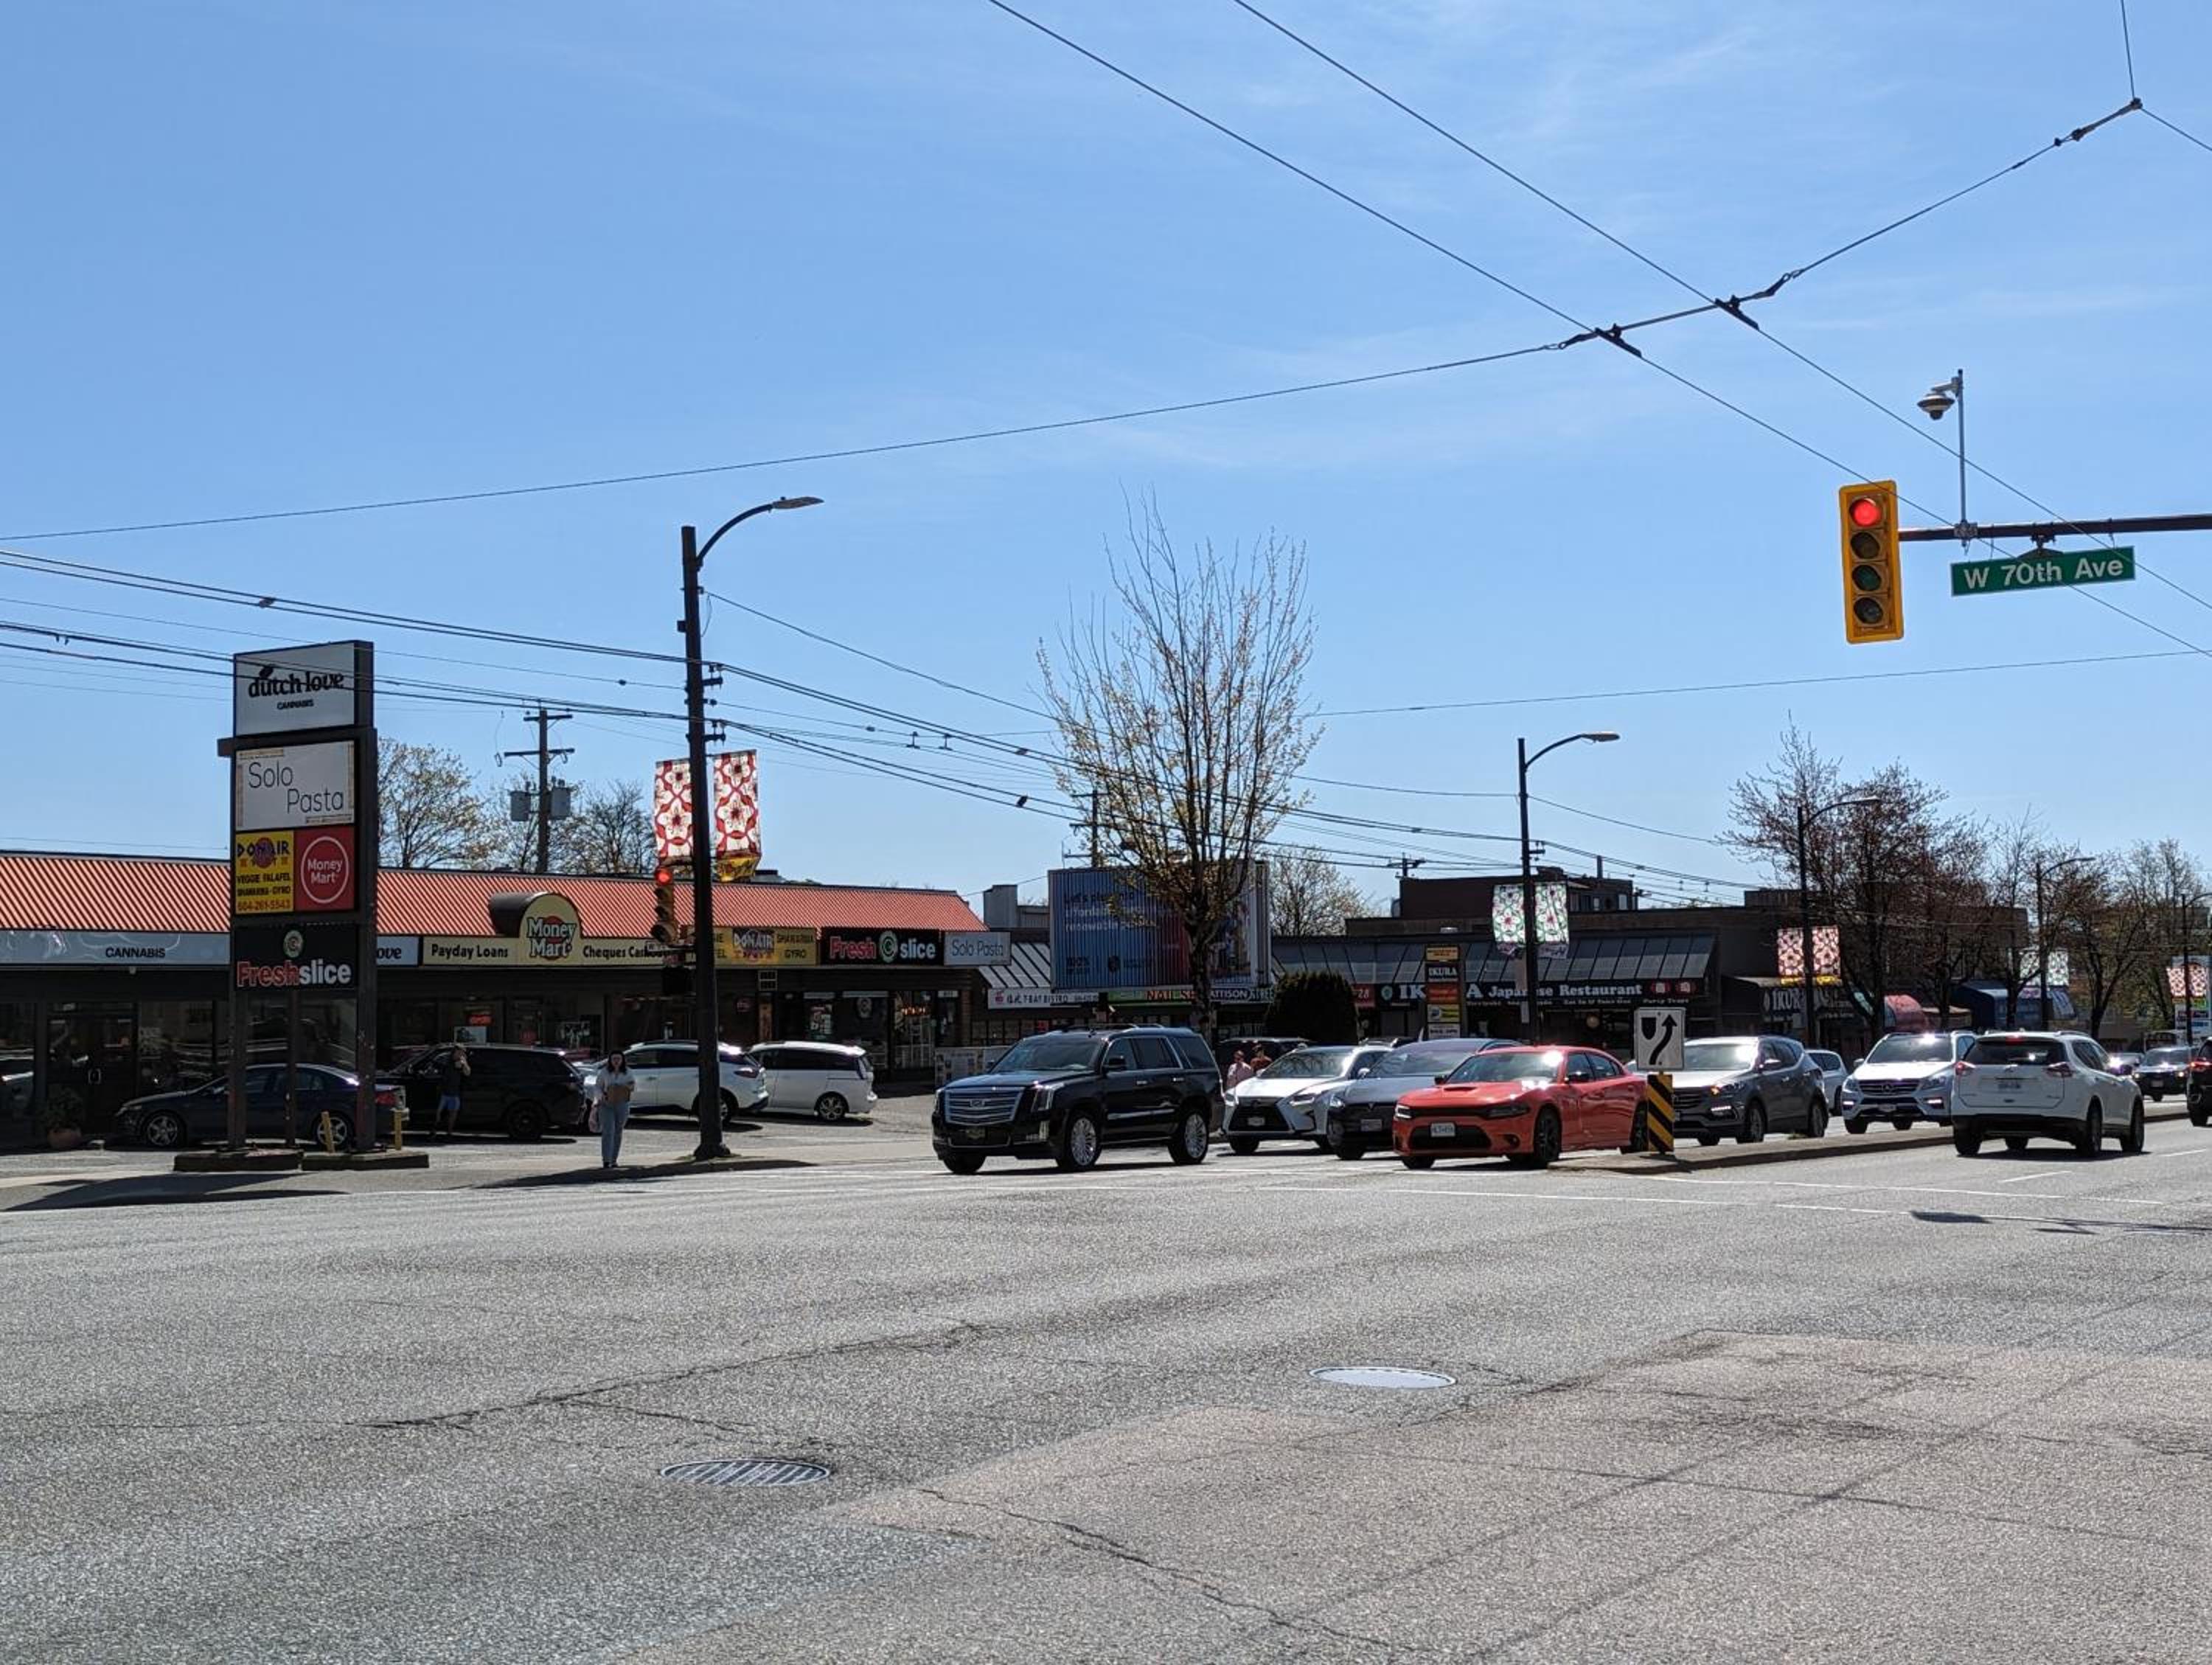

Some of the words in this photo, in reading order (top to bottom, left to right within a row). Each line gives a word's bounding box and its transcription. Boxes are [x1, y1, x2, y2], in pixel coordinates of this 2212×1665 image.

[1964, 567, 1989, 589] W
[2000, 561, 2062, 586] 70th
[2074, 557, 2124, 579] Ave
[248, 672, 302, 698] dutch
[305, 670, 344, 691] love
[248, 759, 293, 788] Solo
[287, 787, 344, 814] Pasta
[307, 858, 343, 872] Money
[310, 872, 336, 884] Mart
[526, 917, 577, 943] Money
[105, 947, 166, 958] CANNABIS
[377, 947, 403, 959] ove
[431, 944, 473, 959] Payday
[477, 945, 508, 958] Loans
[529, 937, 572, 958] Mart
[582, 945, 626, 960] Cheques
[784, 948, 807, 959] GYRO
[830, 936, 877, 959] Fresh
[900, 937, 936, 959] slice
[952, 939, 974, 957] Solo
[977, 940, 1004, 957] Pasta
[1559, 984, 1643, 995] Restaurant
